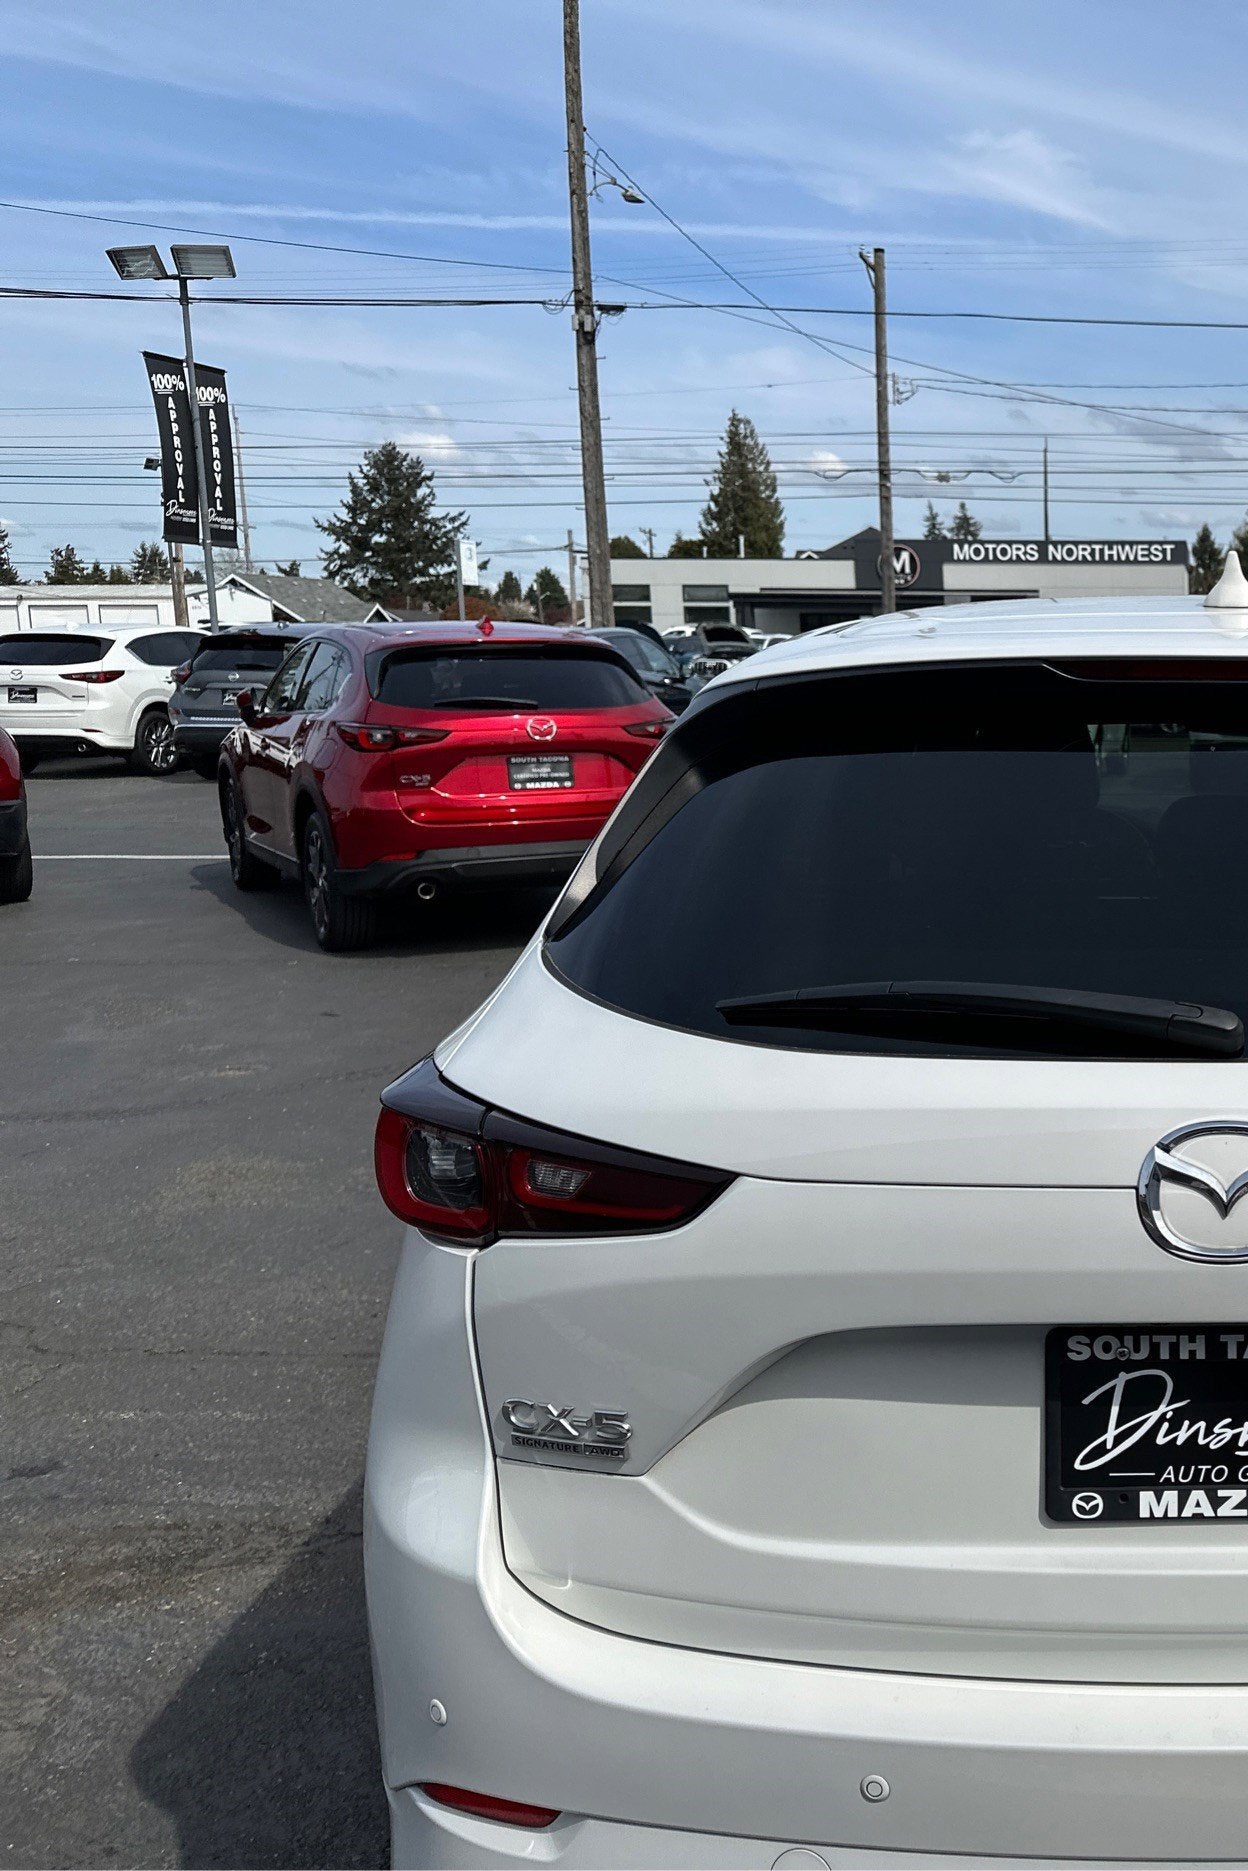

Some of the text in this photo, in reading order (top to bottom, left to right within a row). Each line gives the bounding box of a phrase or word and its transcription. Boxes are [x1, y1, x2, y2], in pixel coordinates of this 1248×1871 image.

[151, 374, 185, 391] 100%
[195, 386, 226, 403] 100%
[167, 396, 185, 503] APPROVAL
[208, 409, 223, 511] APPROVAL
[953, 543, 1175, 562] MOTORS NORTHWEST
[526, 781, 559, 789] MAZDA
[1067, 1334, 1205, 1360] SOUTH
[502, 1398, 633, 1441] CX-5
[513, 1436, 622, 1457] SIGNATURE AWD
[1159, 1465, 1228, 1483] AUTO
